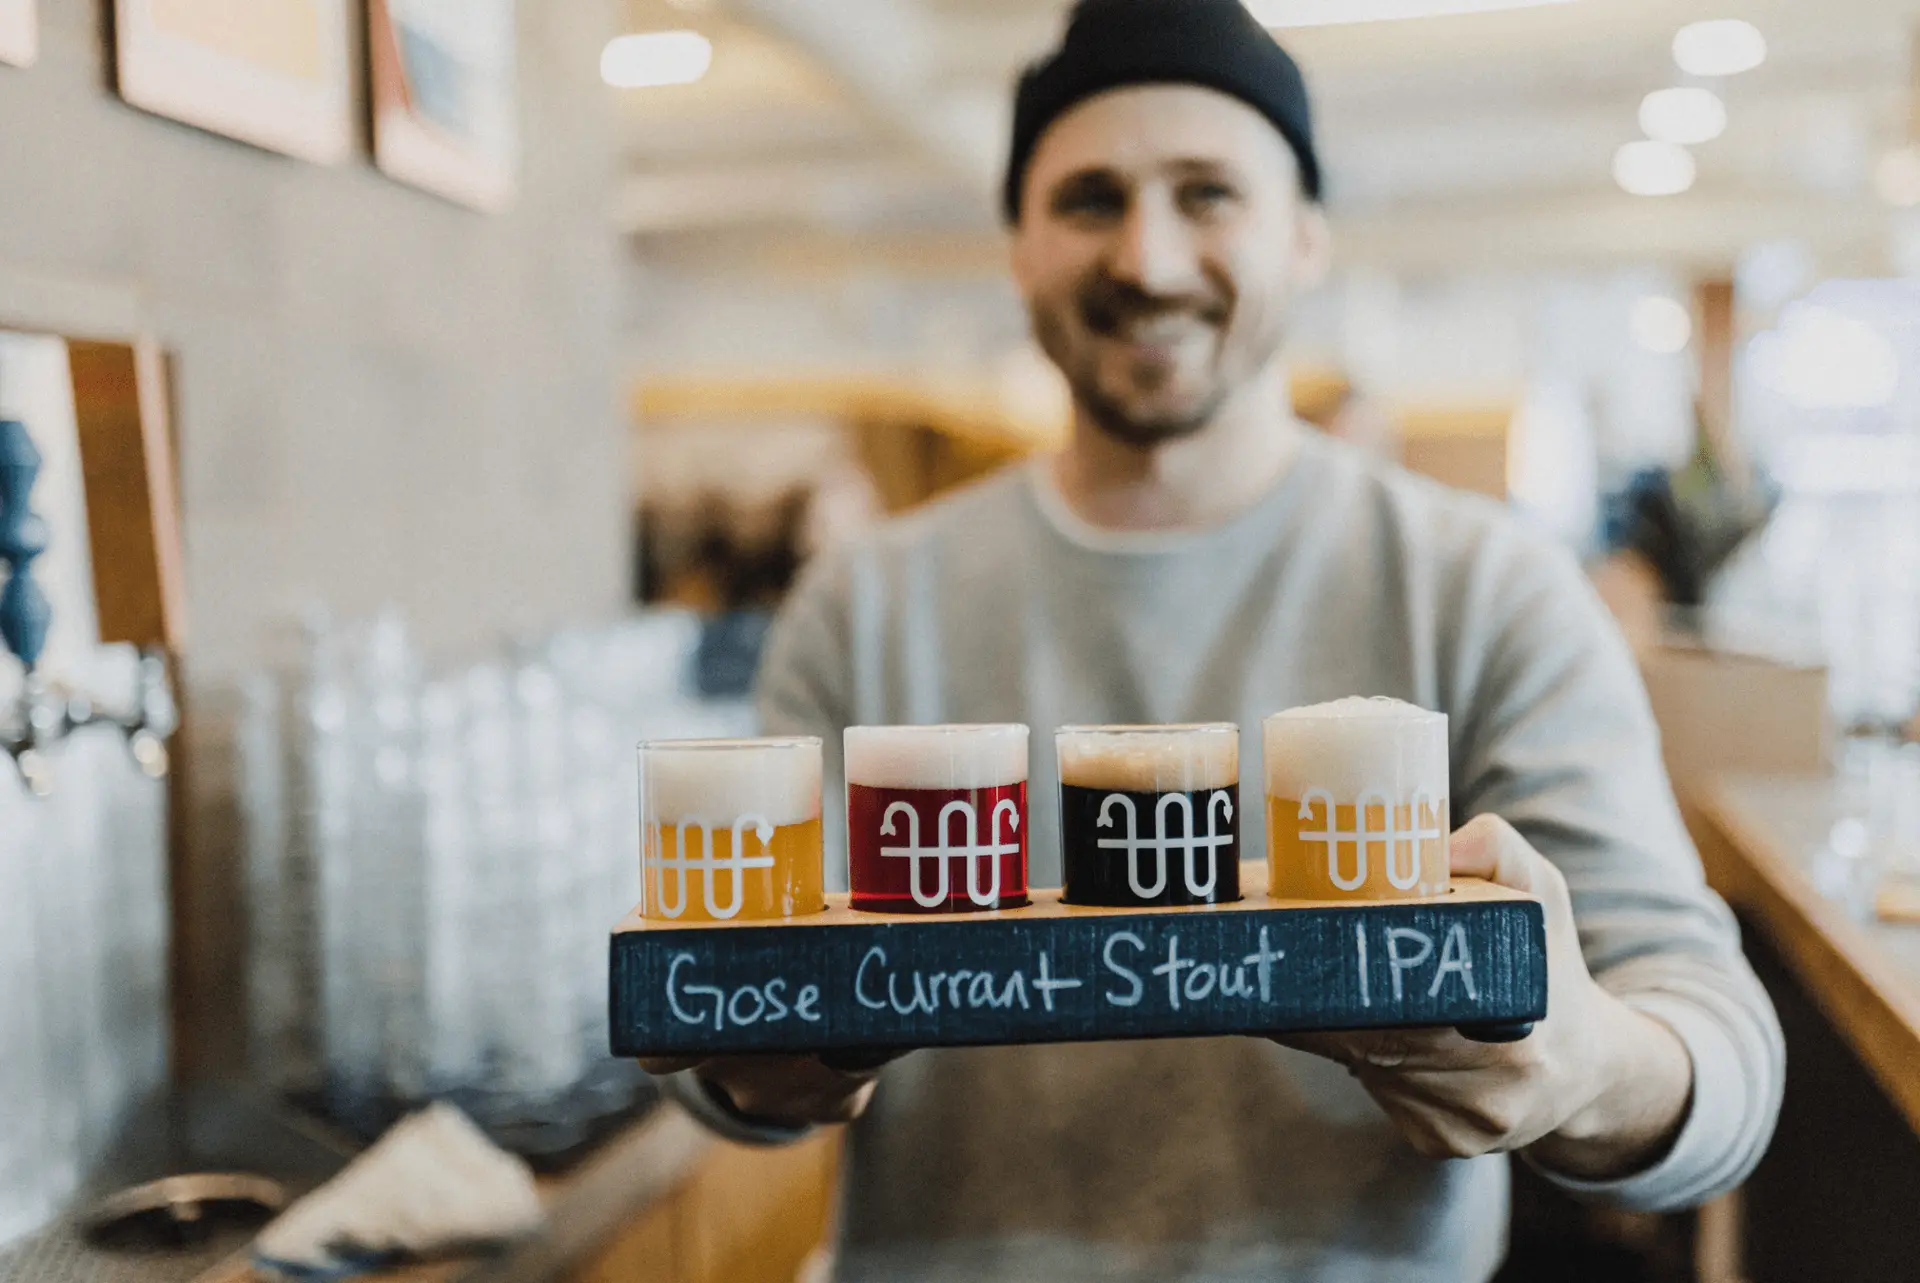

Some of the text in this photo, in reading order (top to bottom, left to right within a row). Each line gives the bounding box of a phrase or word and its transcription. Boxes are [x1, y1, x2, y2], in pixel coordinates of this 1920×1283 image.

[666, 921, 1477, 1031] Gose Currant Stout IPA
